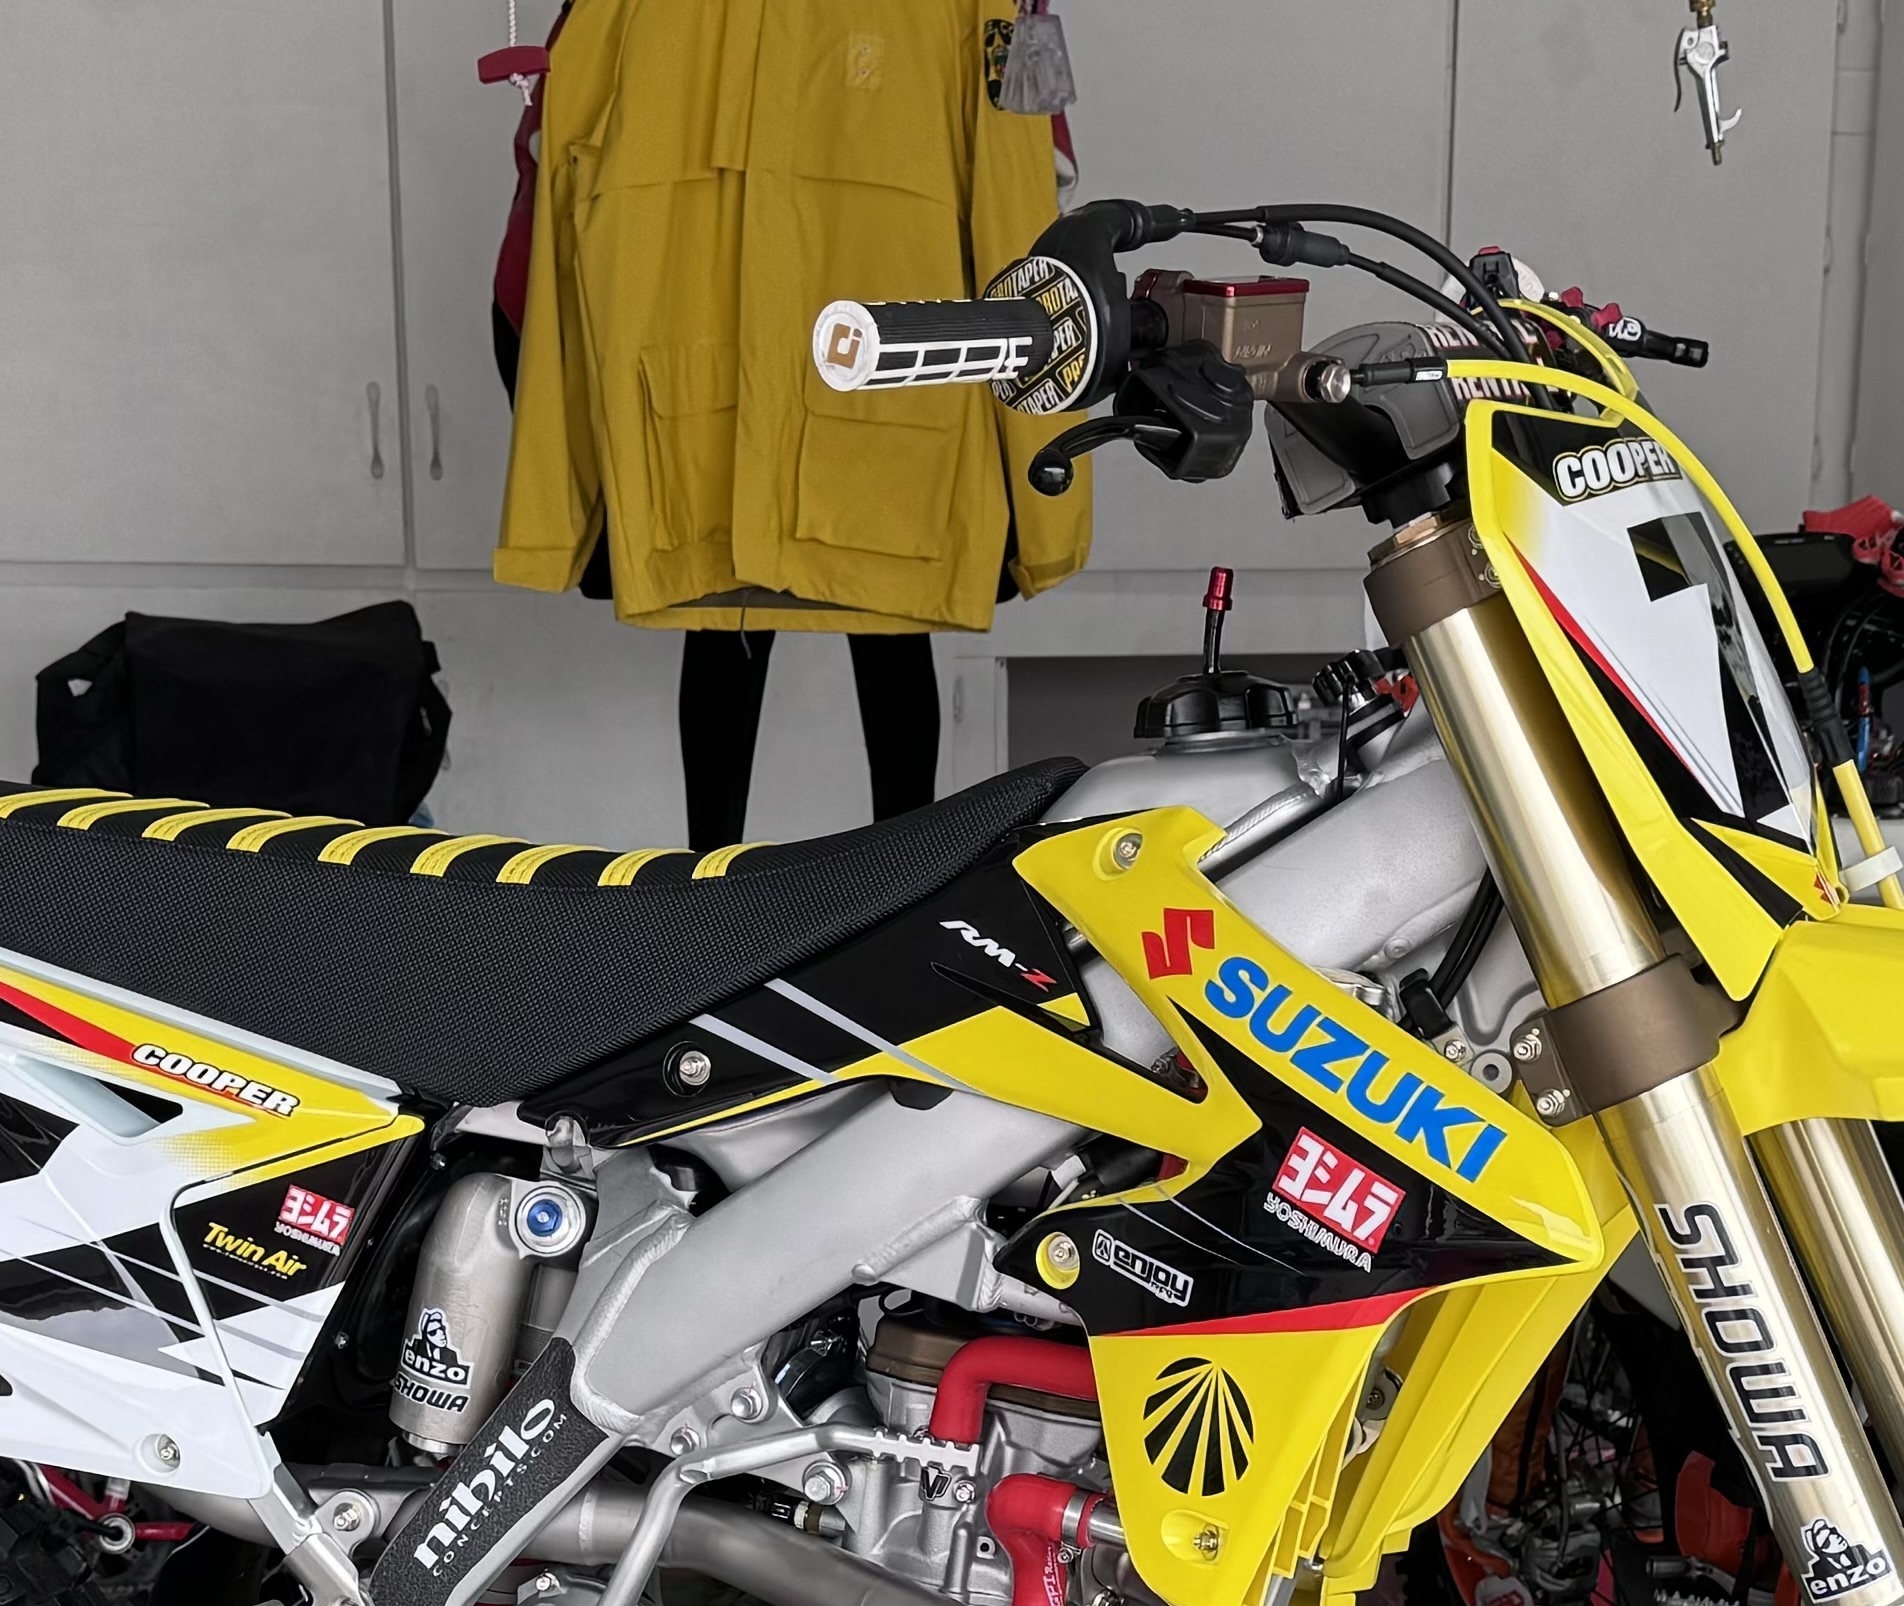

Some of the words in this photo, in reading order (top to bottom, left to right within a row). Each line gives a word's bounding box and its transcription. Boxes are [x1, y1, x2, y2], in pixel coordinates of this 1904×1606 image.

[1627, 511, 1790, 822] 7
[940, 920, 1058, 992] RM-Z
[132, 1044, 300, 1117] COOPER
[1205, 956, 1508, 1183] SUZUKI
[1277, 1141, 1394, 1245] ヨシムラ
[203, 1221, 266, 1263] Twin
[264, 1249, 308, 1277] Air
[1263, 1191, 1374, 1273] YOSHIMURA
[1112, 1241, 1193, 1303] enjoy
[405, 1347, 466, 1382] enzo
[1659, 1203, 1831, 1481] SHOWA
[395, 1371, 470, 1413] SHOWA
[414, 1398, 556, 1569] nihilo
[1810, 1555, 1887, 1596] enzo
